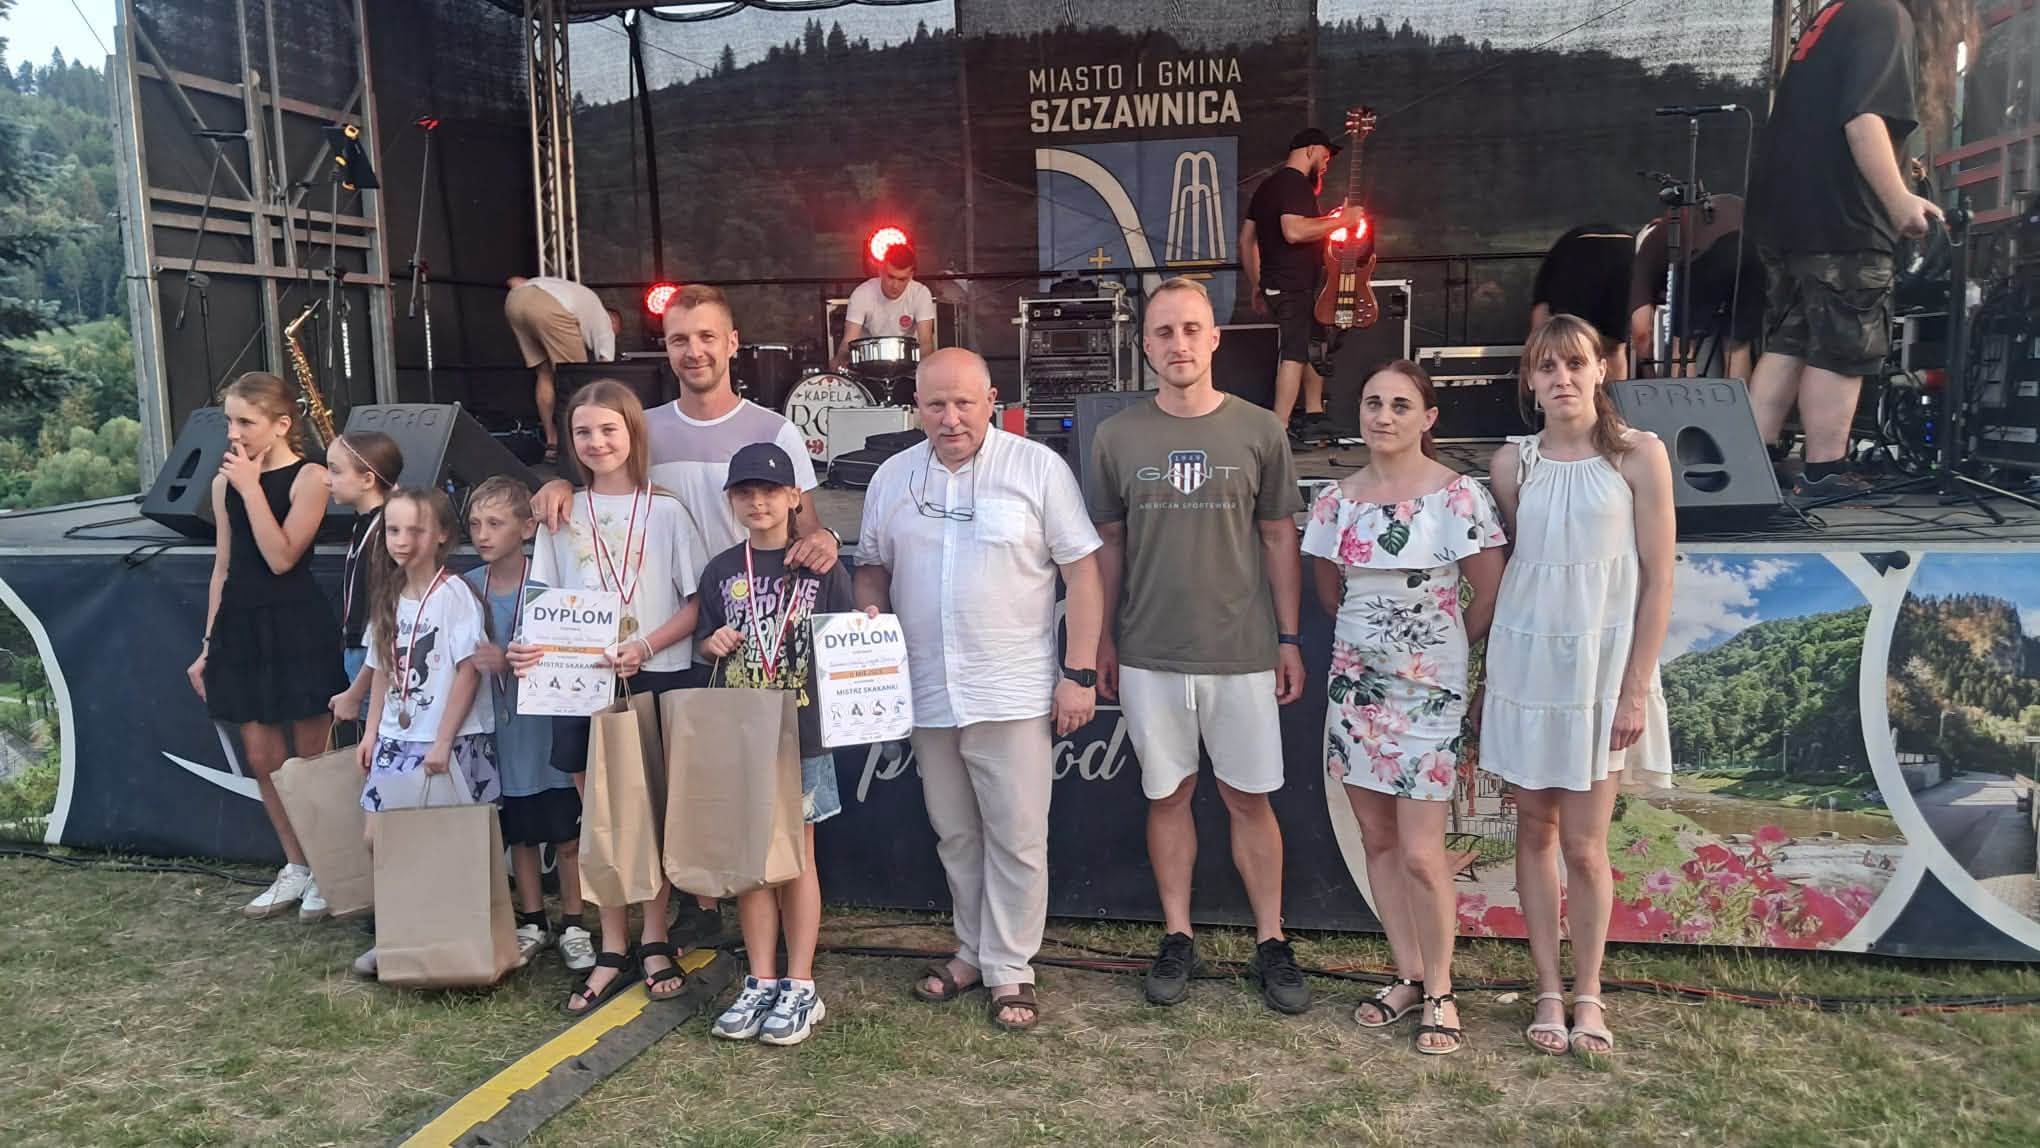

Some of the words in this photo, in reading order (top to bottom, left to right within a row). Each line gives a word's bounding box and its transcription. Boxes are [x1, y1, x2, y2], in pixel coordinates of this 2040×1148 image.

[1029, 64, 1123, 94] MIASTO
[1137, 63, 1142, 88] I
[1158, 57, 1242, 87] GMINA
[1030, 89, 1241, 133] SZCZAWNICA
[804, 391, 853, 401] KAPELA
[533, 606, 613, 625] DYPLOM
[824, 629, 899, 649] DYPLOM
